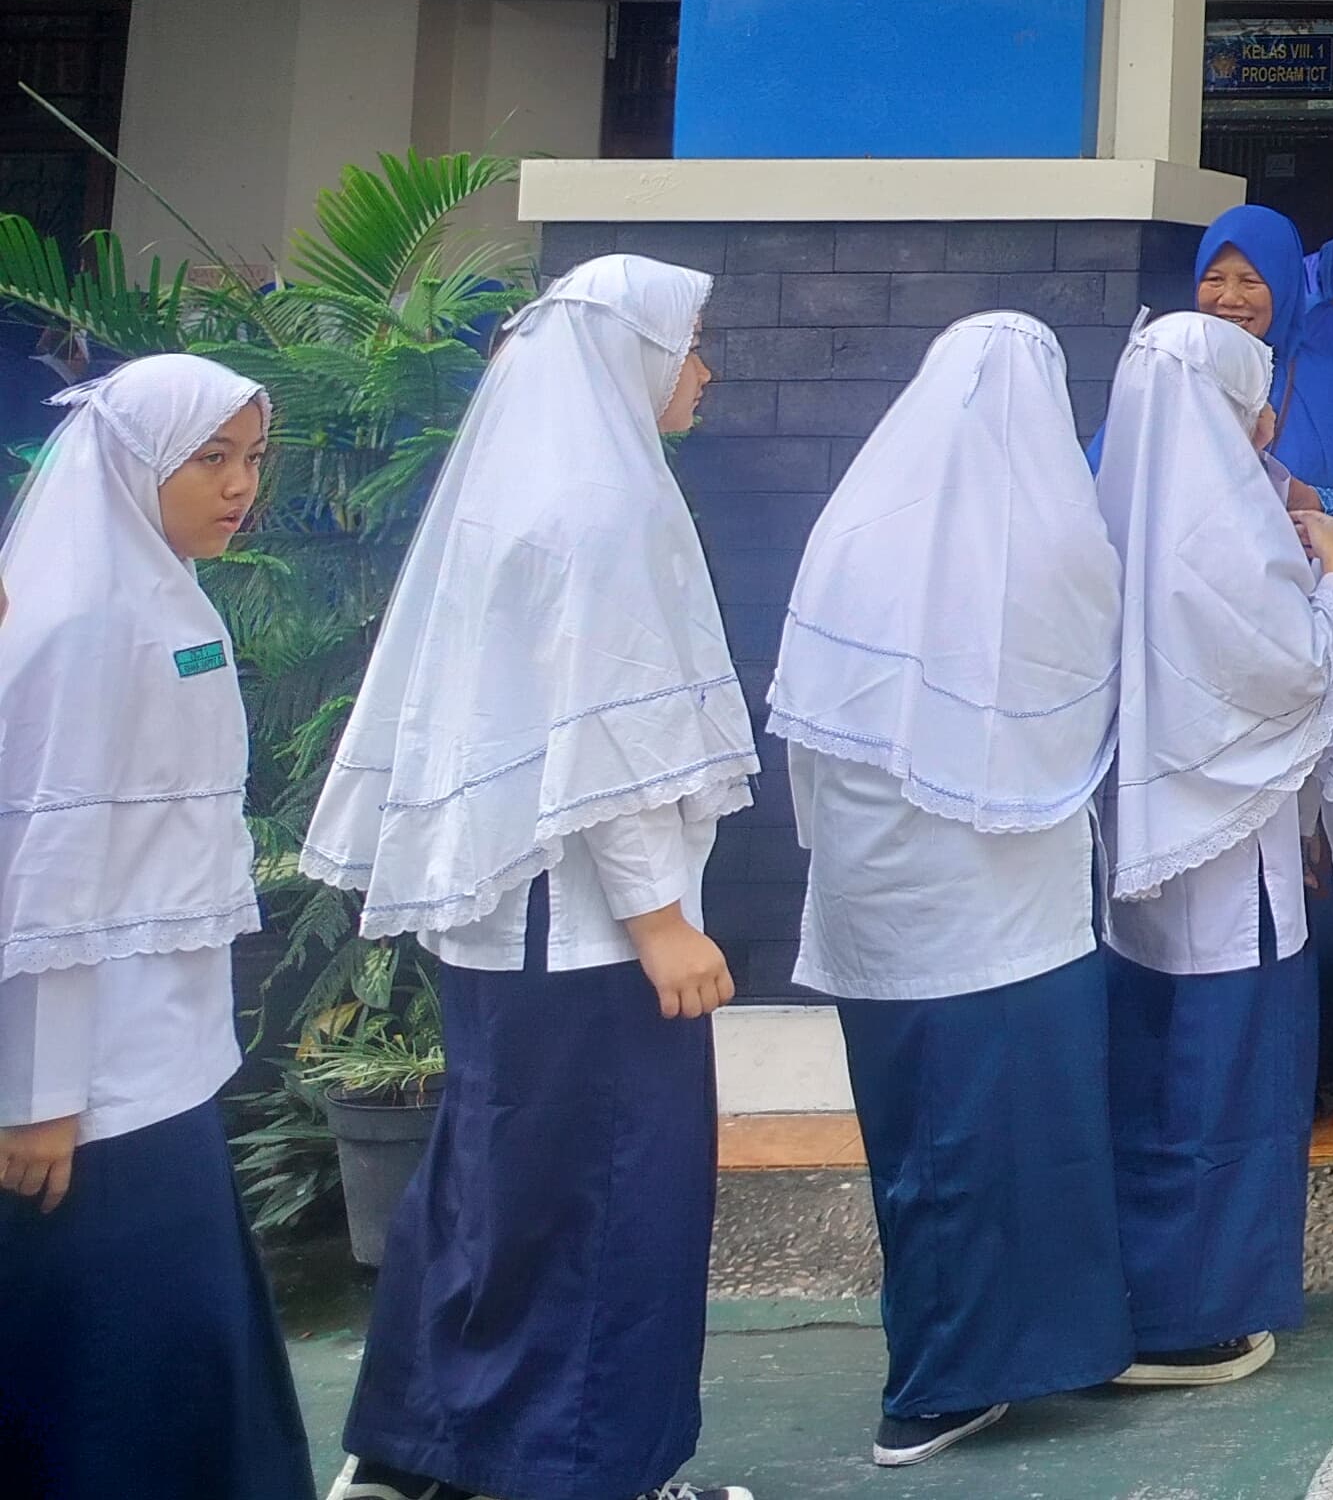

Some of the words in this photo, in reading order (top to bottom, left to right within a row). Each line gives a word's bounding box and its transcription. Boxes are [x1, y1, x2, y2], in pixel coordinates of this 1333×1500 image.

[1241, 43, 1287, 60] KELAS
[1318, 43, 1325, 59] 1
[1241, 66, 1304, 82] PROGRAM
[1306, 66, 1326, 81] ICT
